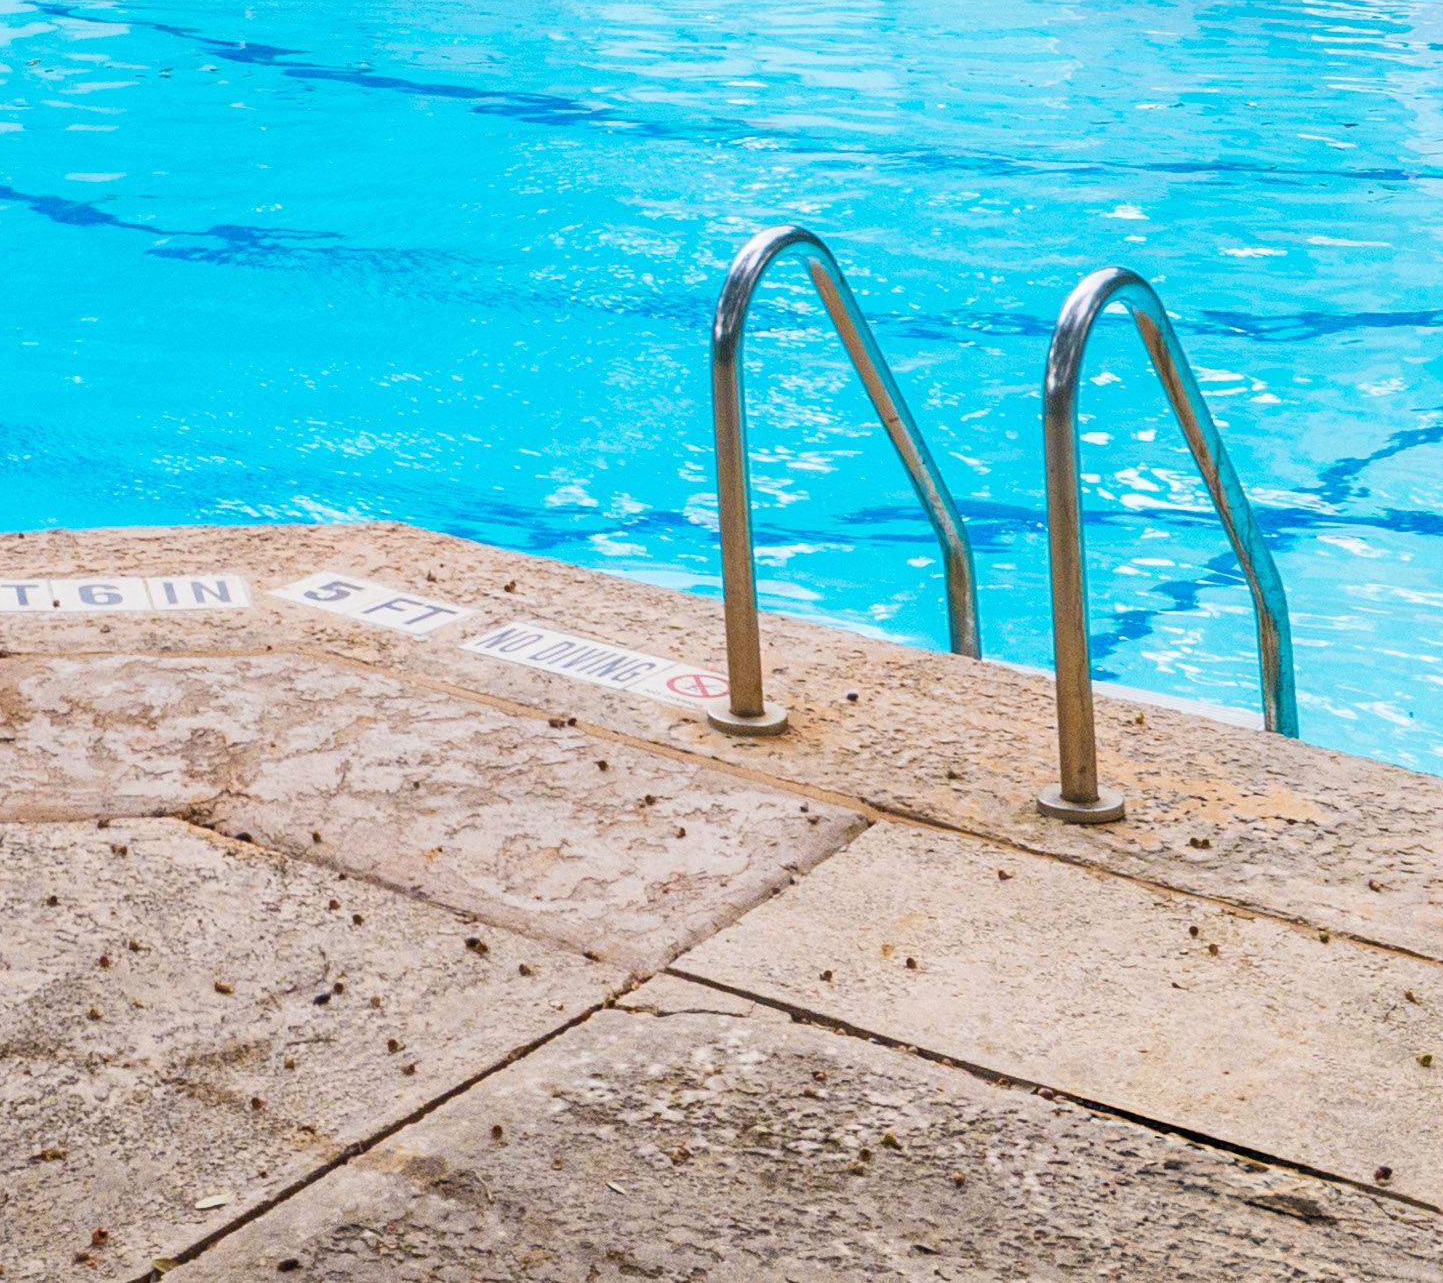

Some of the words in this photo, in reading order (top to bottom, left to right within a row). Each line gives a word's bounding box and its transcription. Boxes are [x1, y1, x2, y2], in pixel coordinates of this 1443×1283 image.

[78, 584, 123, 605] 6
[163, 580, 232, 604] IN
[303, 580, 365, 602] 5
[361, 597, 459, 625] FT
[474, 628, 544, 653] NO
[528, 641, 656, 681] DIVING
